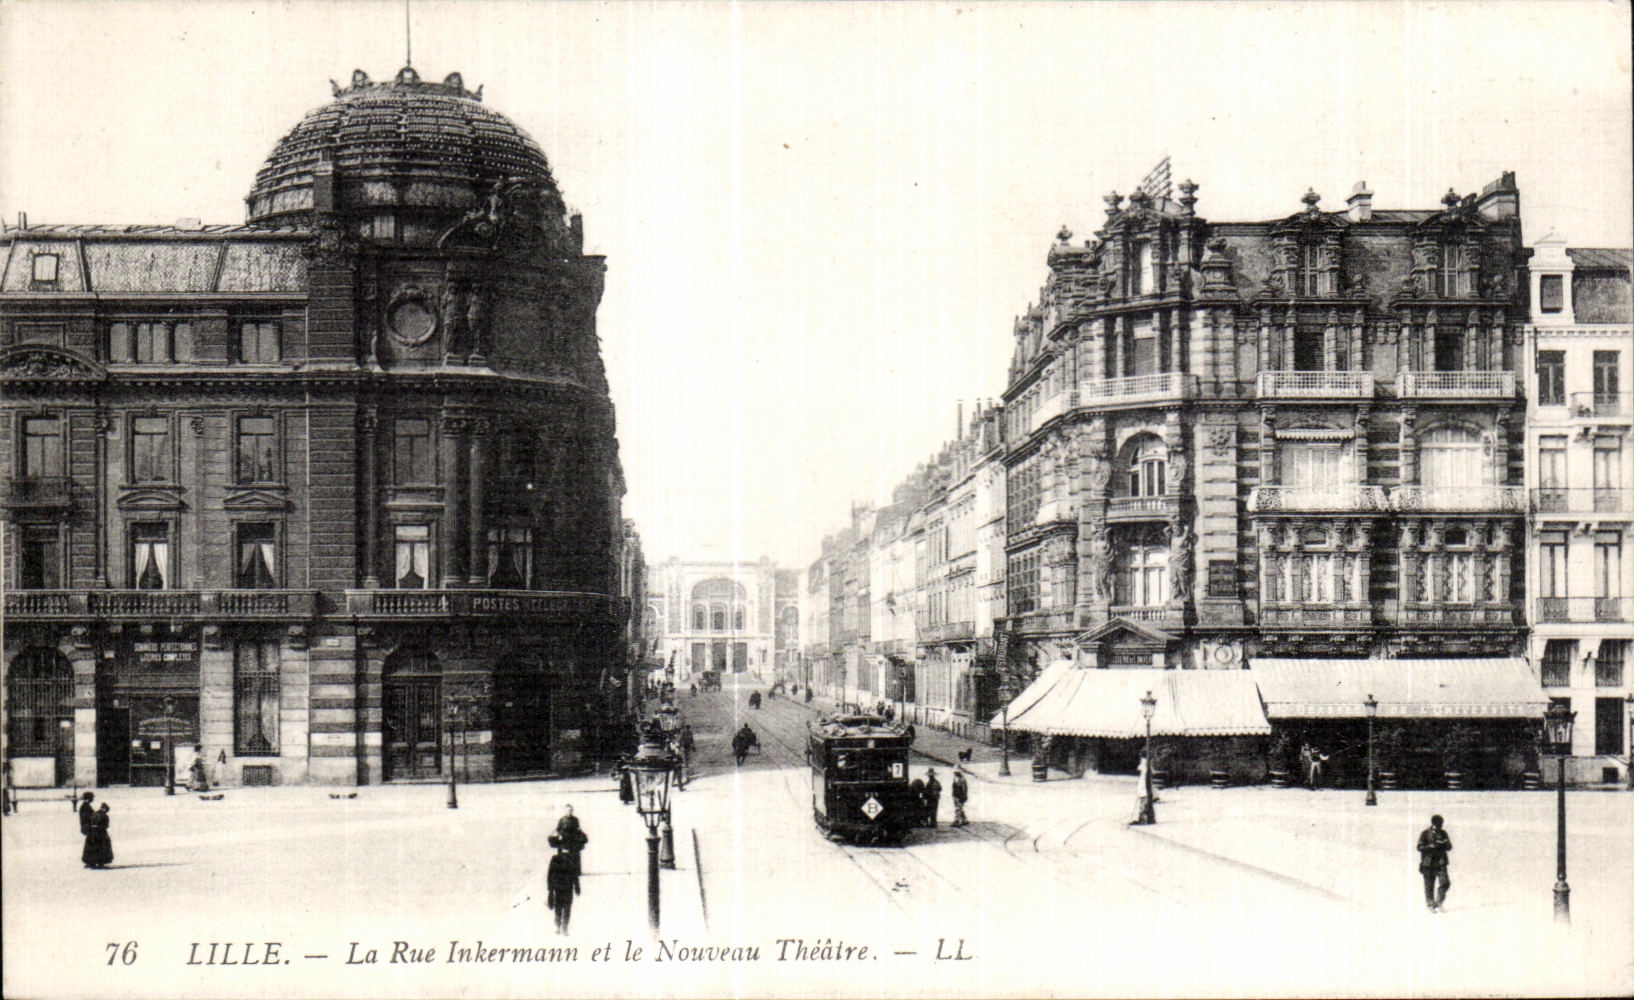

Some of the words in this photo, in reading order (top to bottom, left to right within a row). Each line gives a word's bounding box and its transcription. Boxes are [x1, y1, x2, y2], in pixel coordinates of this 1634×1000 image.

[472, 597, 520, 611] POSTES
[1390, 704, 1408, 716] DE
[867, 802, 879, 814] B
